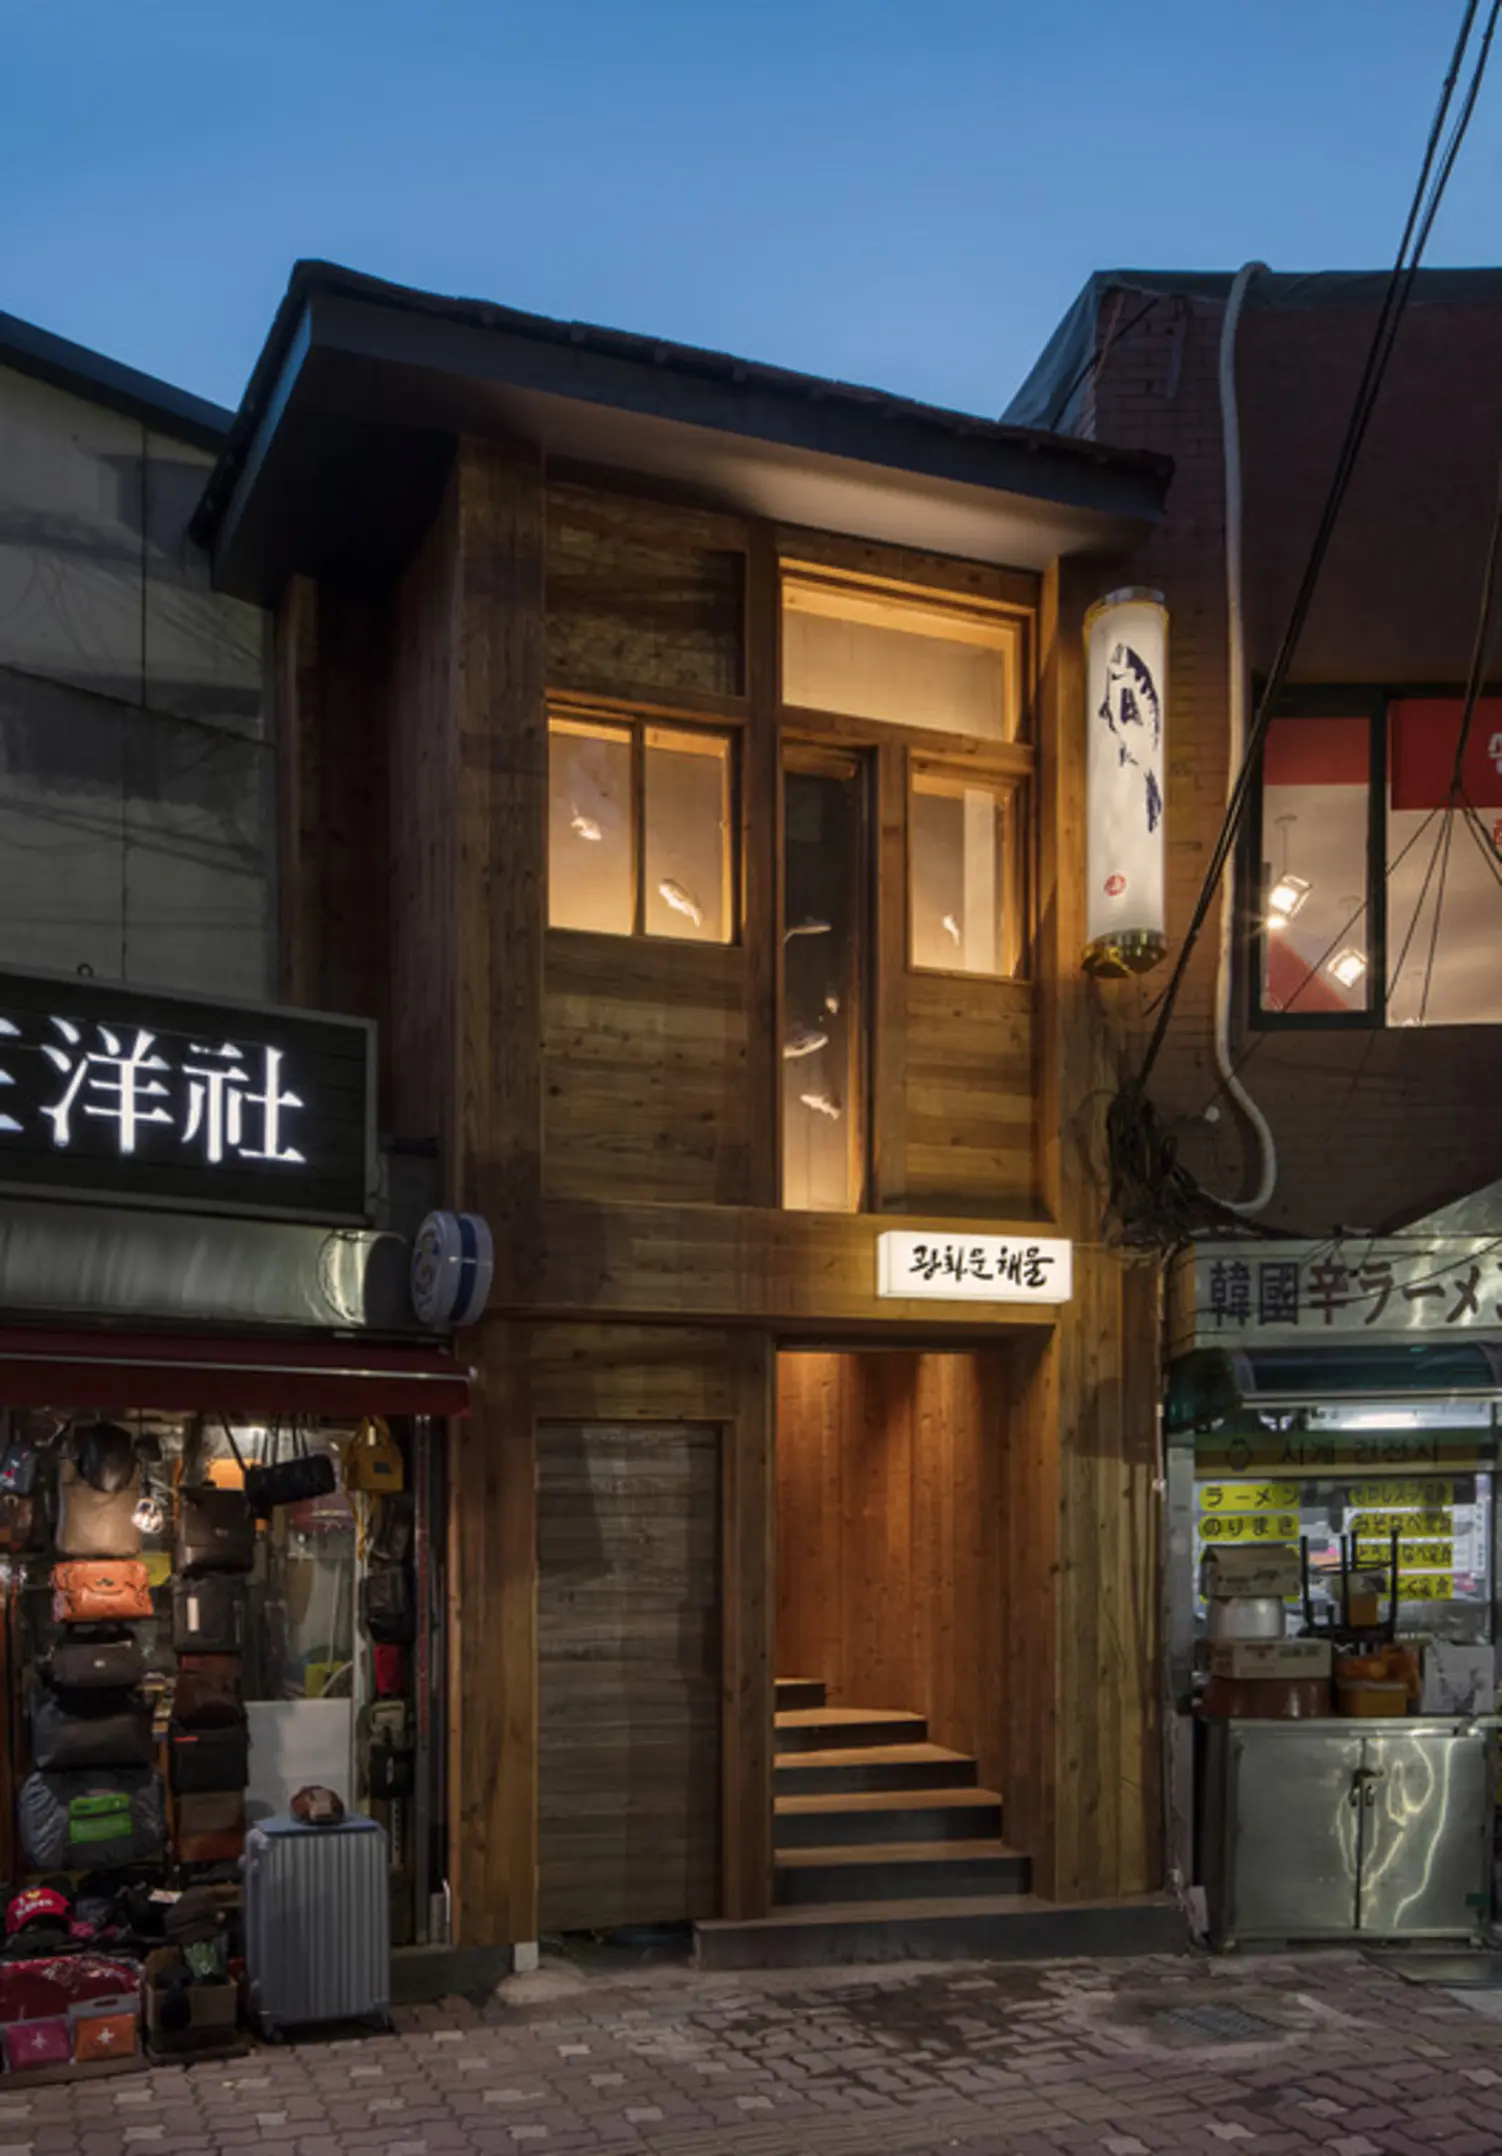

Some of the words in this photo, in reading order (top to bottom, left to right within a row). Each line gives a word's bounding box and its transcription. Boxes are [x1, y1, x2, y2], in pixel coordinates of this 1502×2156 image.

[0, 1017, 306, 1164] 洋社
[909, 1244, 994, 1282] 광화문
[1205, 1486, 1299, 1508] ラーメン
